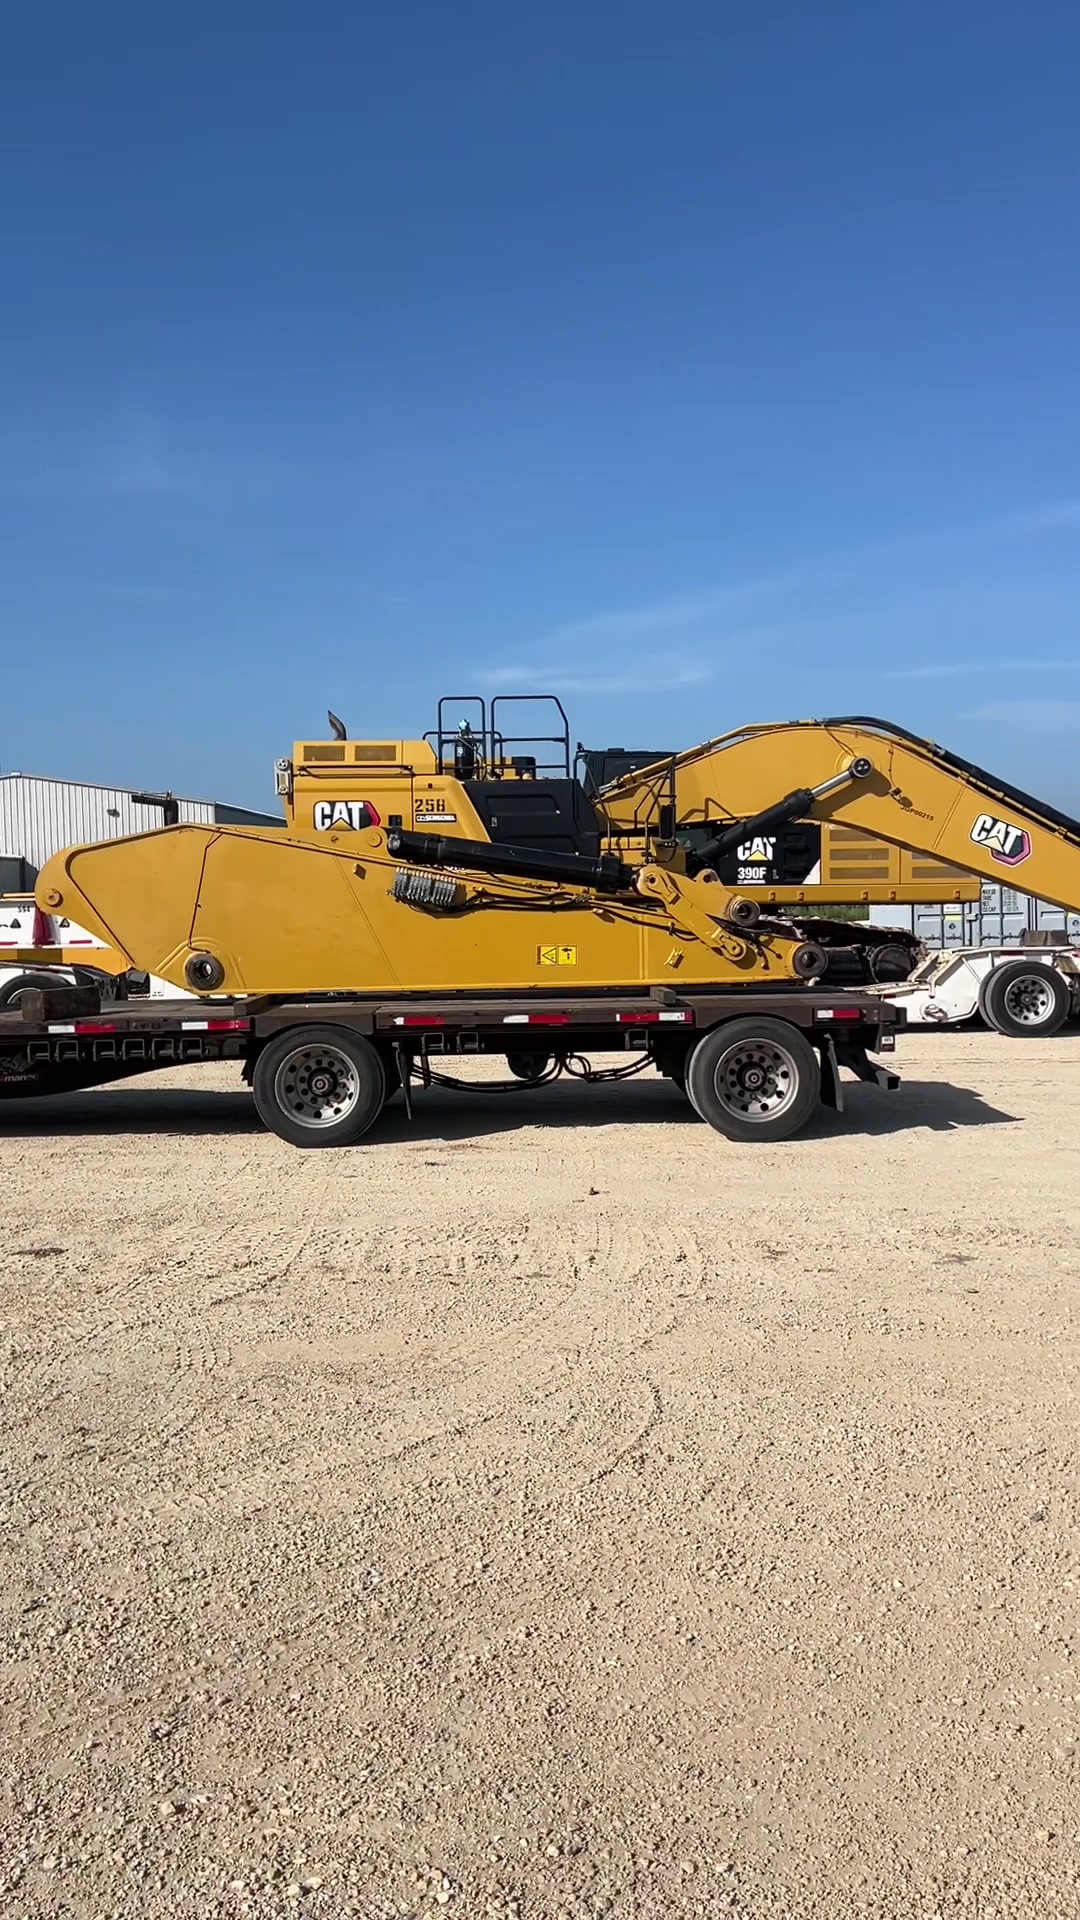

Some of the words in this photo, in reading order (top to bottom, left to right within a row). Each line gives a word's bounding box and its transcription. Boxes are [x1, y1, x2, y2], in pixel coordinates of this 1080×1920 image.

[315, 801, 364, 831] CAT
[970, 814, 1023, 855] CAT
[737, 837, 777, 861] CAT
[737, 867, 767, 879] 390F
